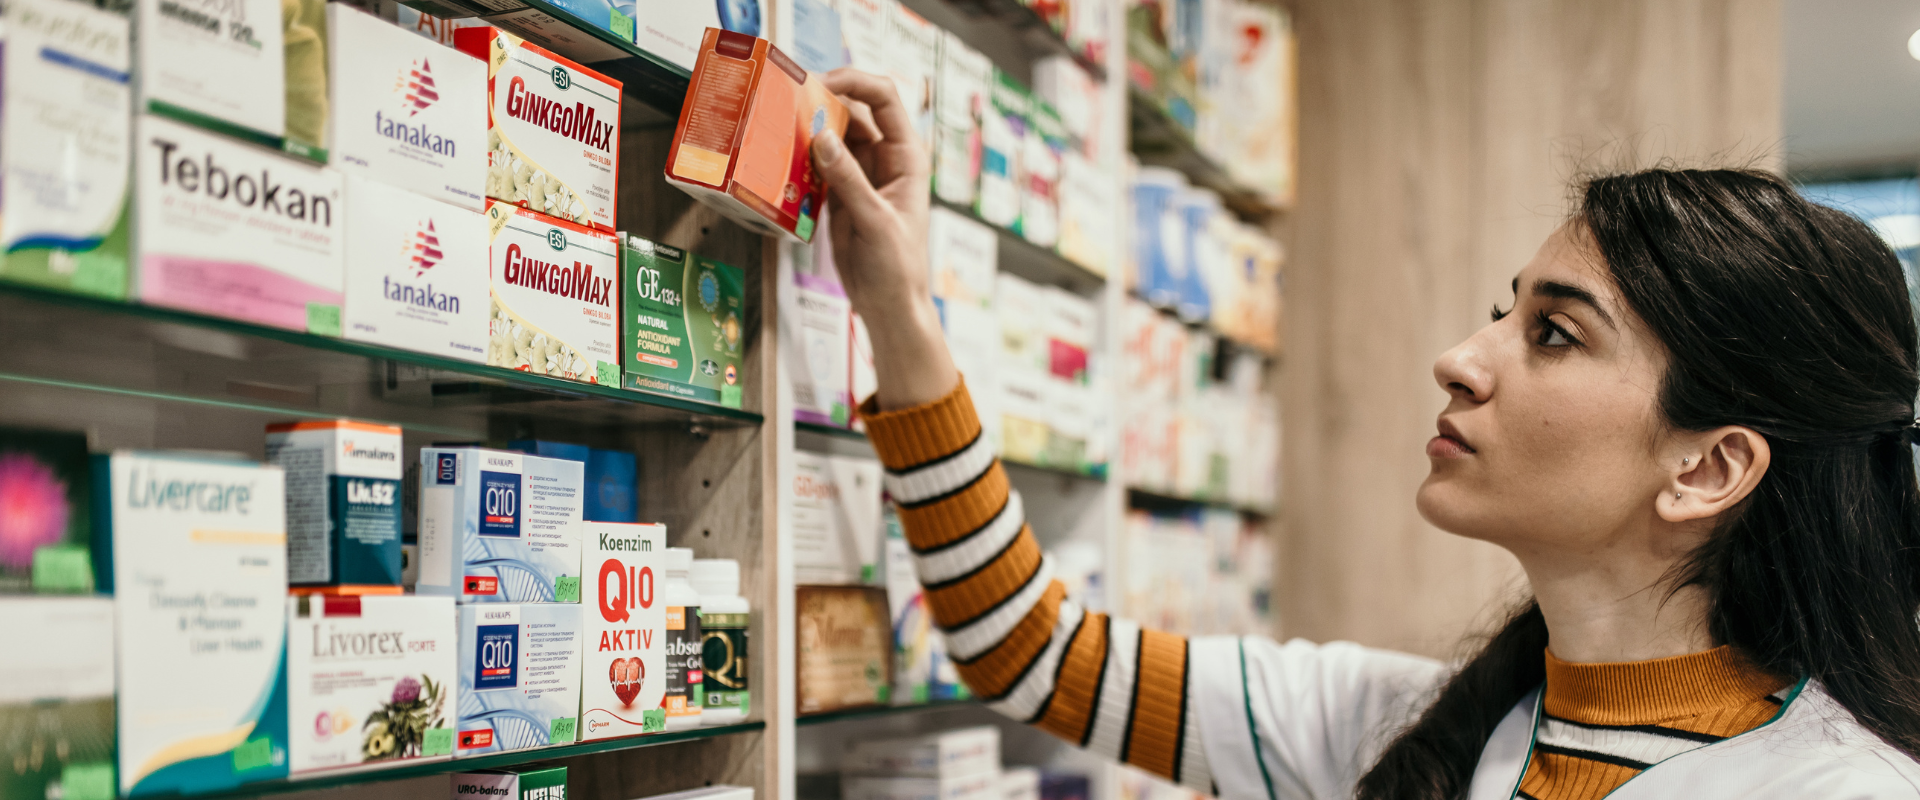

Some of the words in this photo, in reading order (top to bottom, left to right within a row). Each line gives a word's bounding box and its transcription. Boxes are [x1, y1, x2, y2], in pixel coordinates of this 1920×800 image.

[552, 69, 569, 88] ESI
[374, 109, 456, 158] tanakan
[151, 137, 332, 227] Tebokan
[549, 231, 565, 249] ESI
[383, 275, 460, 315] tanakan
[636, 266, 661, 302] GE
[637, 314, 669, 331] NATURAL
[637, 329, 681, 347] ANTIOXIDANT
[637, 339, 671, 355] FORMULA
[636, 375, 669, 391] Antioxidant
[129, 465, 251, 515] Livercare
[485, 487, 516, 516] Q10
[599, 532, 652, 552] Koenzim
[598, 558, 654, 624] Q10
[484, 611, 511, 620] ALKAKAPS
[312, 623, 404, 657] Livorex
[407, 640, 436, 652] FORTE
[599, 629, 653, 652] AKTIV
[482, 640, 512, 669] Q10
[457, 784, 509, 796] URO-balans
